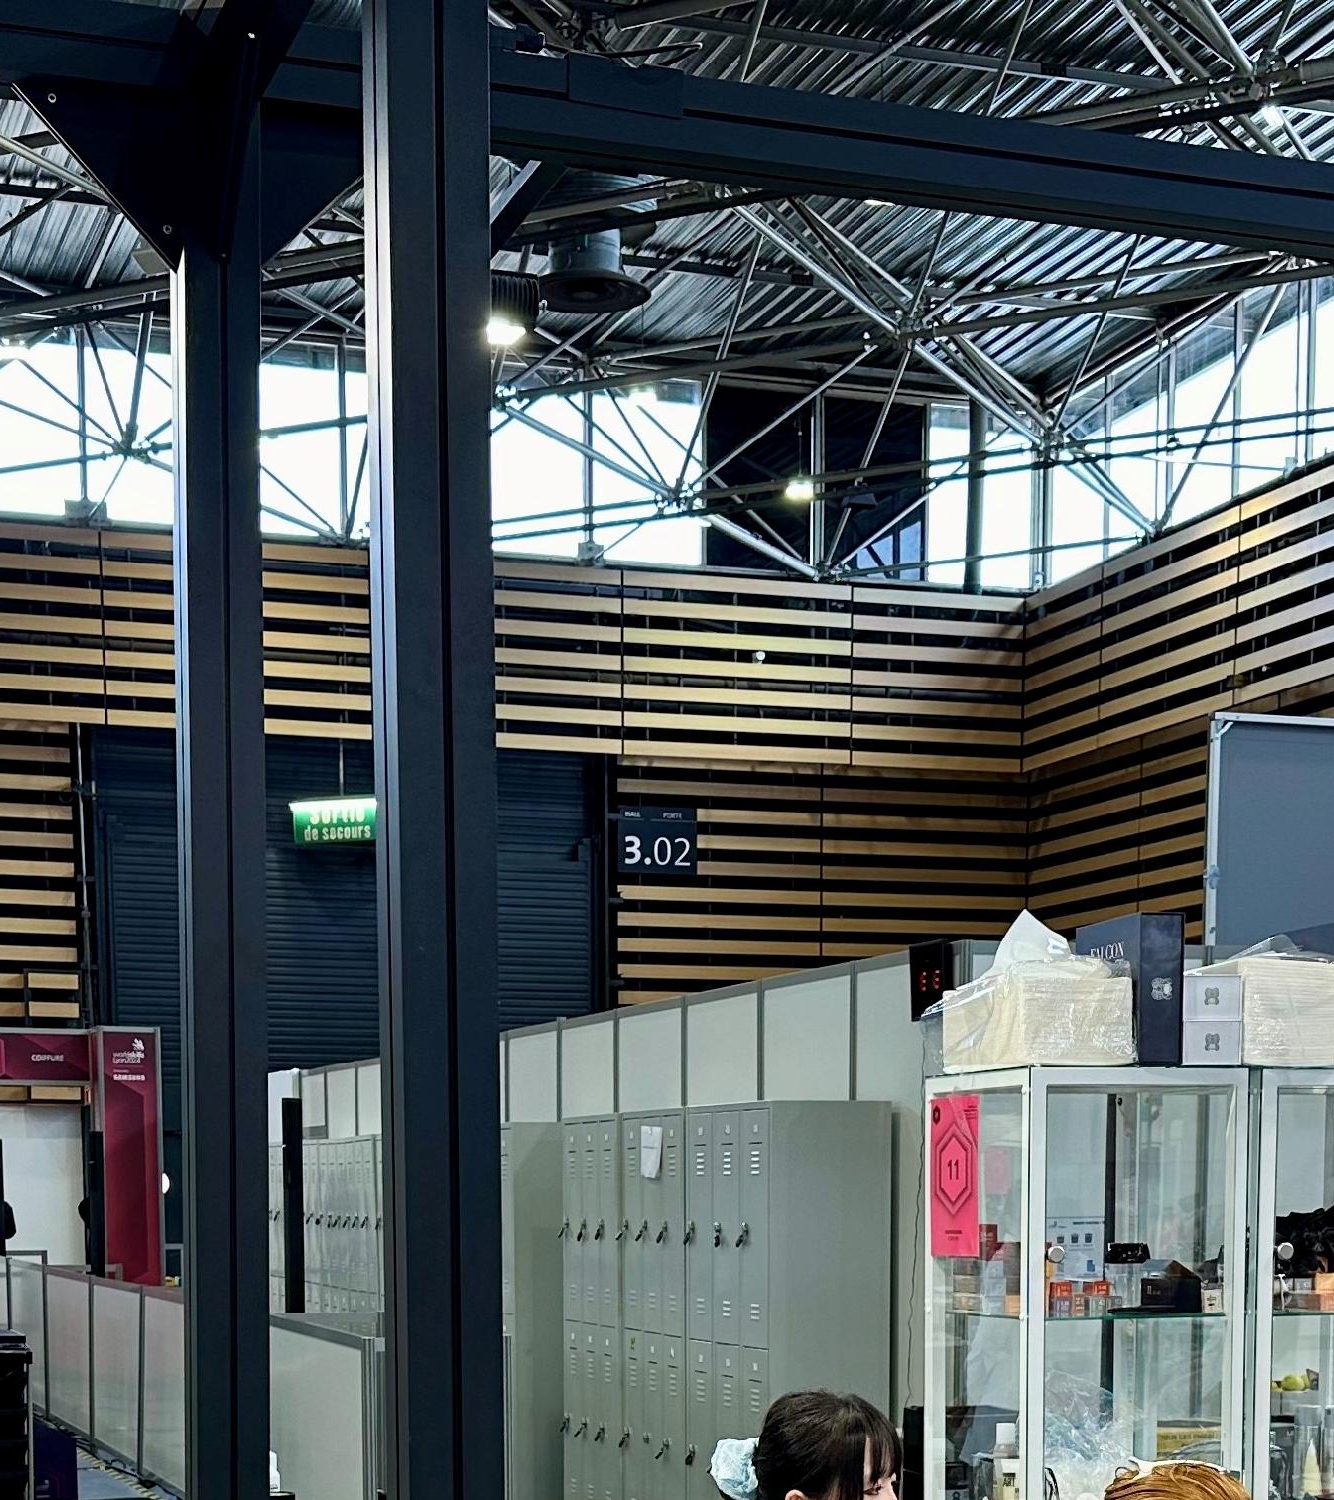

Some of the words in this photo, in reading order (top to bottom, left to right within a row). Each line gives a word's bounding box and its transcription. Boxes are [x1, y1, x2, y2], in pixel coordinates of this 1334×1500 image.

[303, 825, 319, 841] de
[322, 824, 372, 841] secours
[624, 835, 691, 867] 3.02
[947, 1159, 960, 1181] 11
